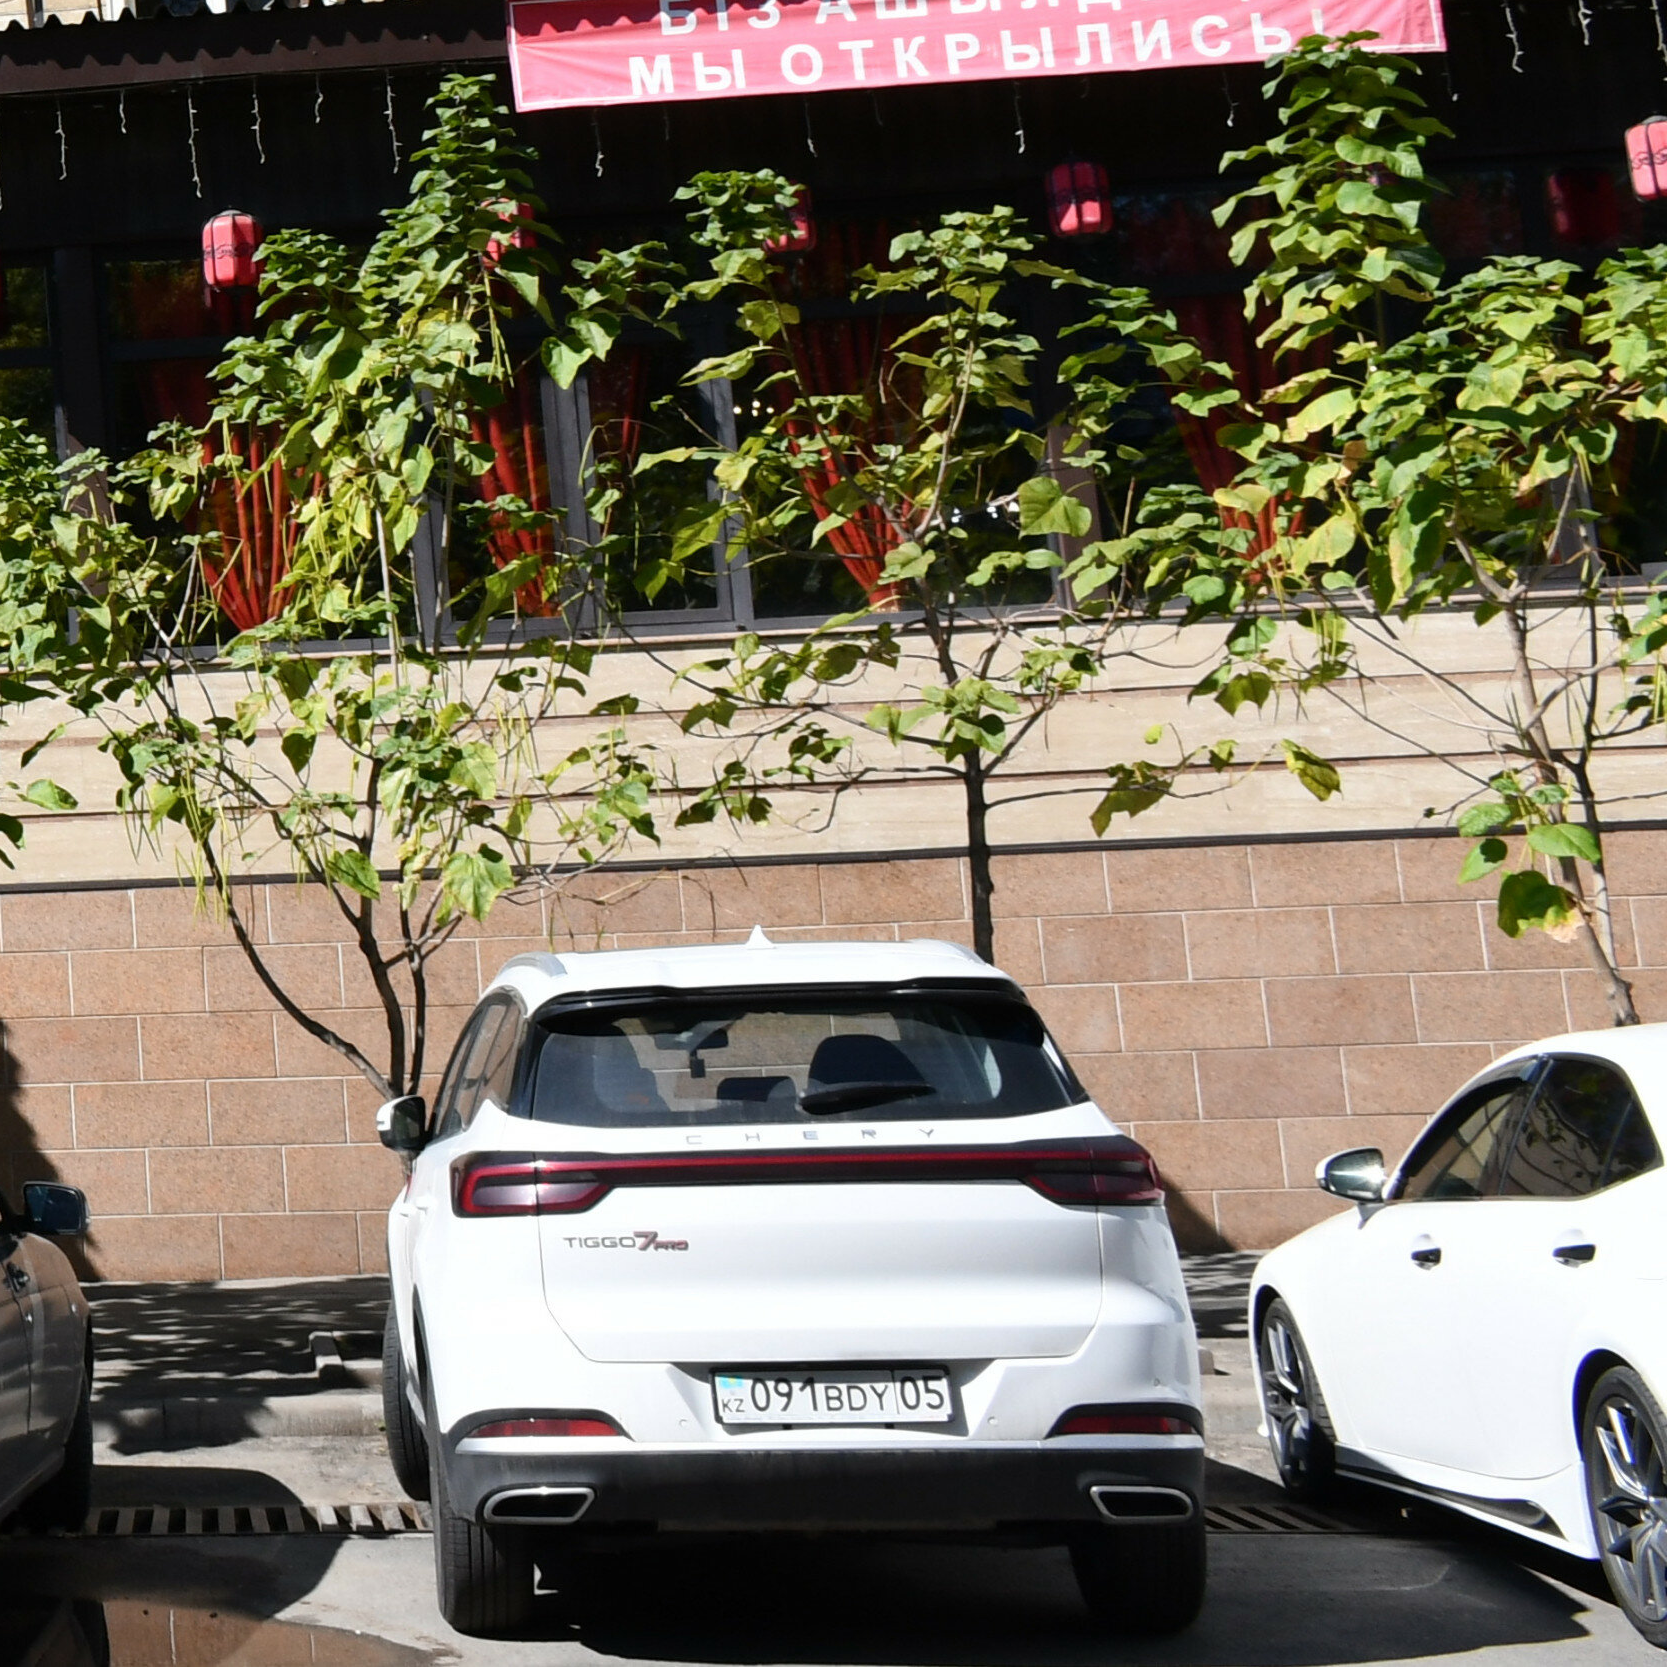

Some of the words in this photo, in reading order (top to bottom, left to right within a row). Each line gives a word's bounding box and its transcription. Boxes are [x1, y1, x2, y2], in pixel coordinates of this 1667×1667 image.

[629, 49, 746, 95] МЫ
[685, 1127, 935, 1145] CHERY
[722, 1398, 745, 1413] KZ
[900, 1374, 945, 1411] 05
